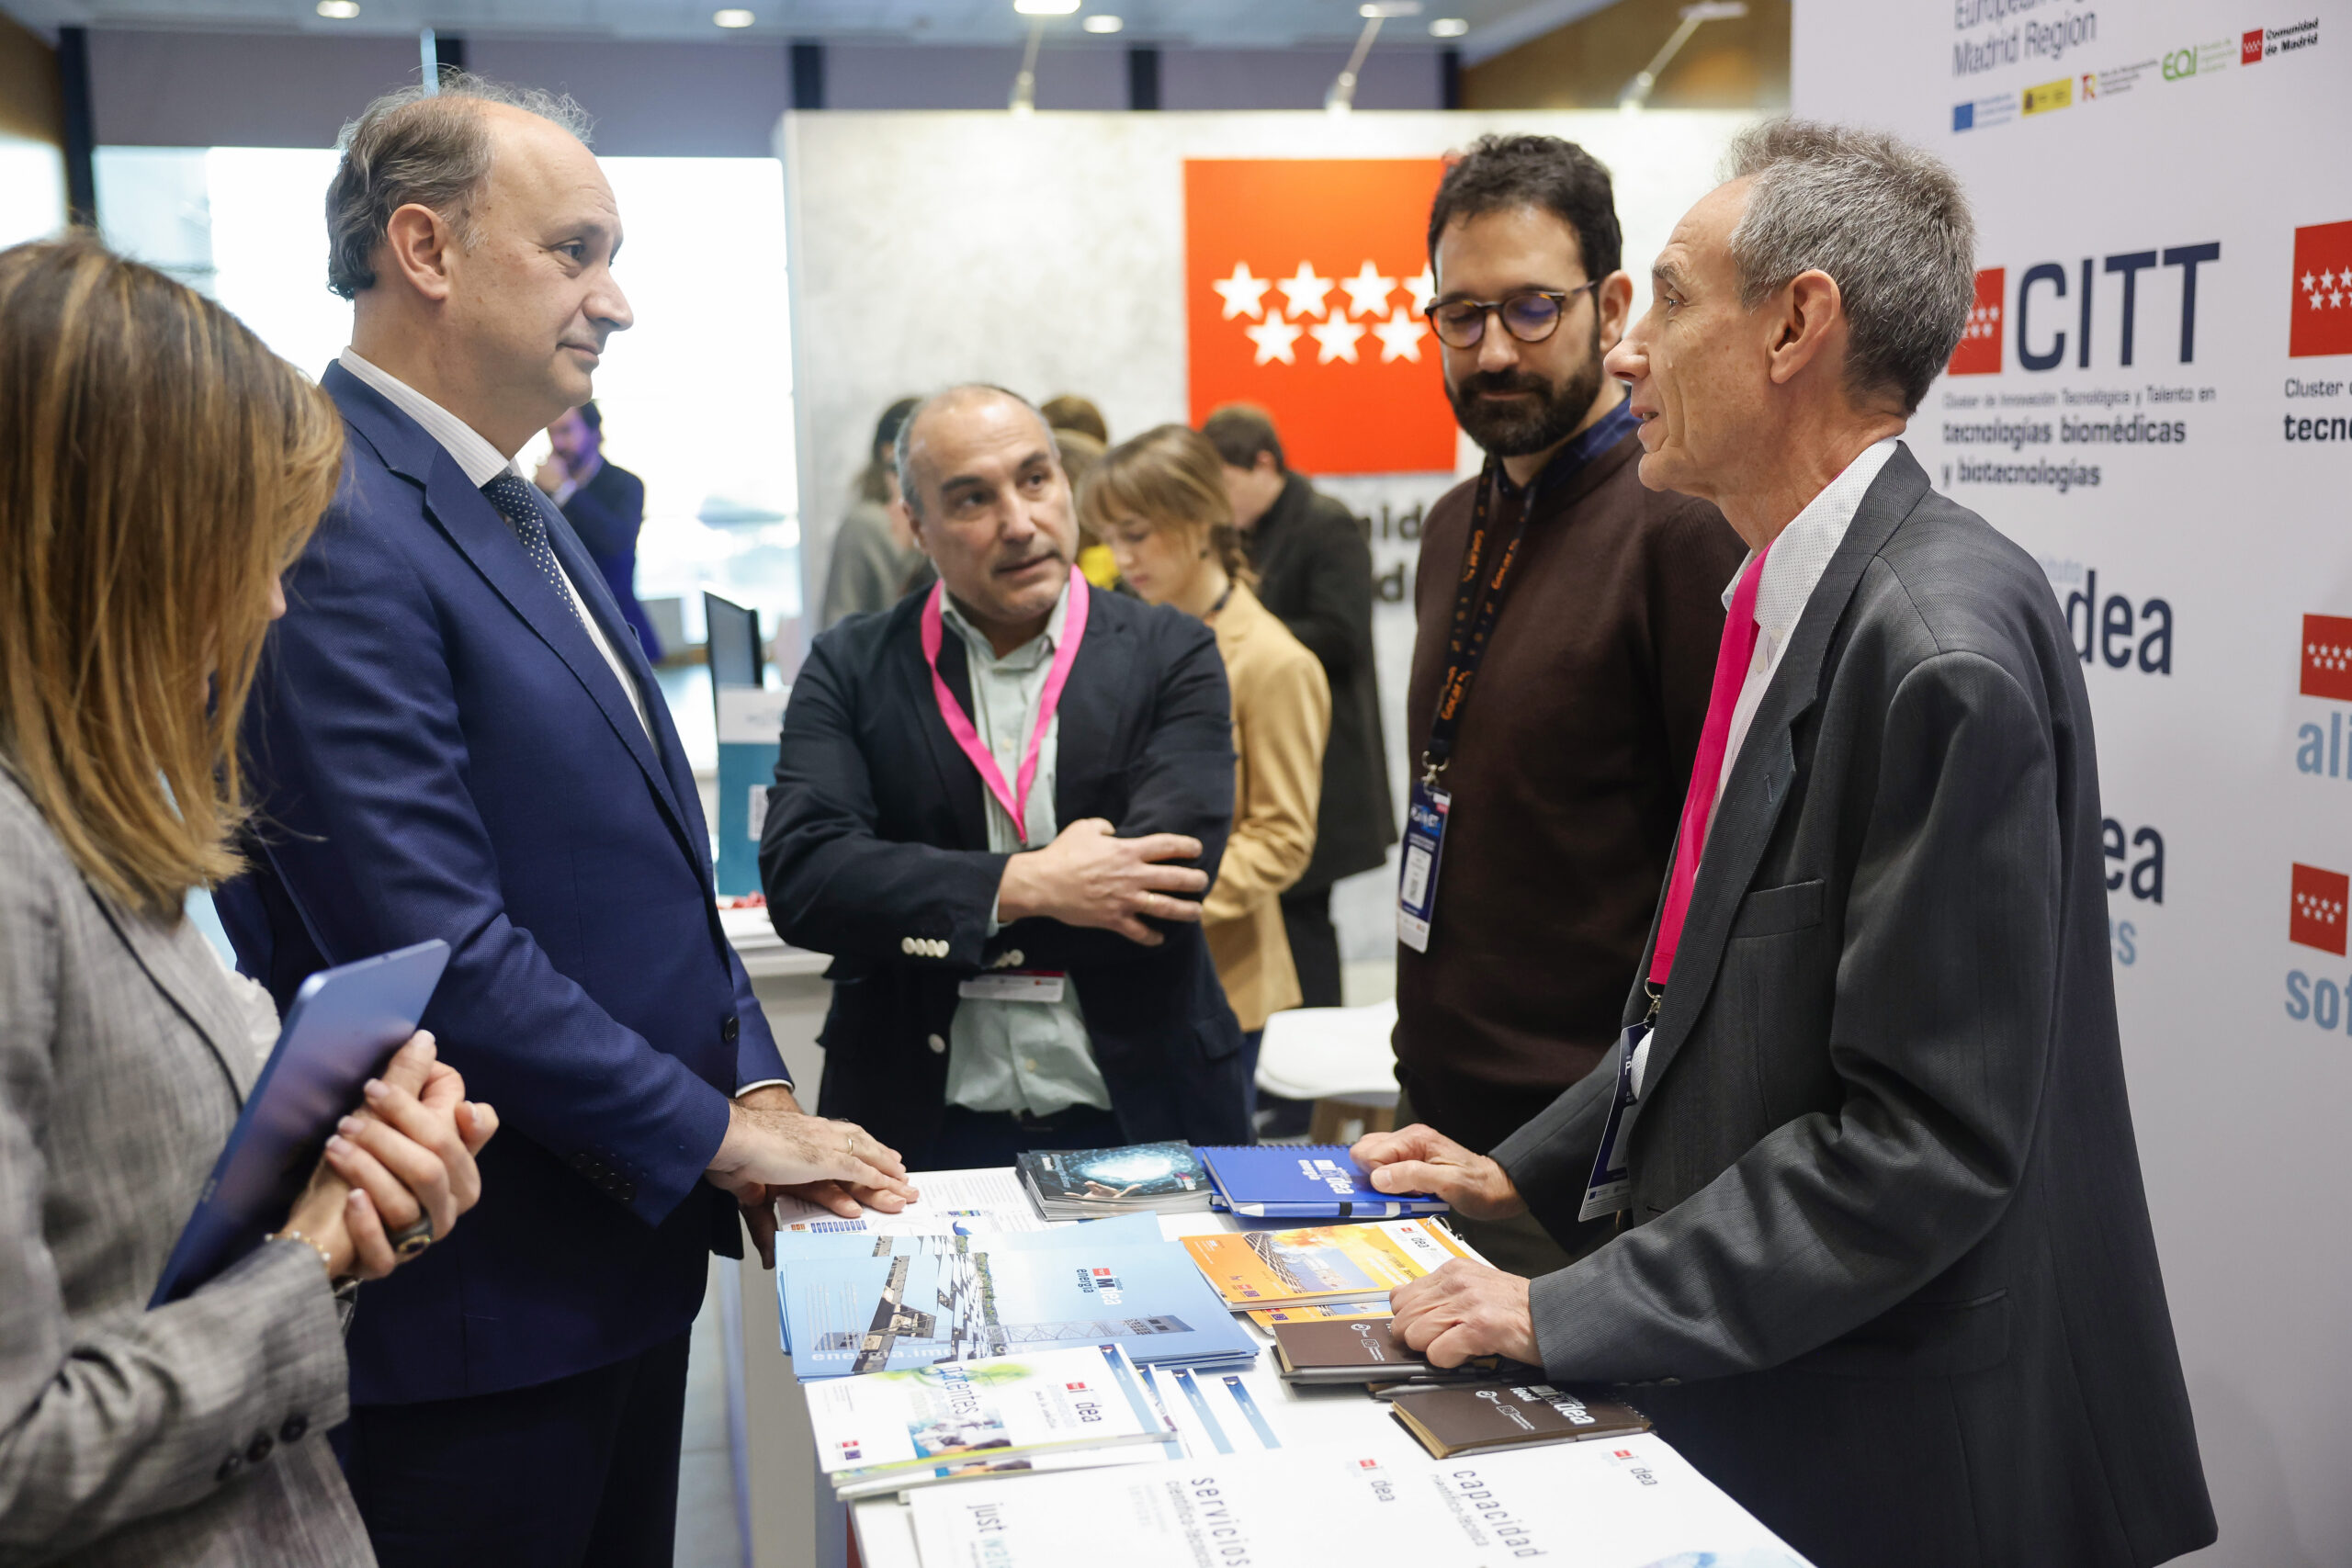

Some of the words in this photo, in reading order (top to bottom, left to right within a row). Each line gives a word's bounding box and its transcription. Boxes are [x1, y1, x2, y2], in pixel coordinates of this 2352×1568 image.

[1952, 26, 2019, 77] Madrid
[2024, 11, 2097, 61] Region
[2265, 17, 2318, 40] Comunidad
[2281, 31, 2318, 52] Madrid
[2016, 242, 2221, 372] CITT
[2146, 385, 2194, 402] Talento
[2198, 386, 2216, 402] en
[2285, 378, 2343, 398] Cluster
[1943, 414, 2052, 451] tecnologías
[2060, 413, 2187, 444] biomédicas
[2284, 412, 2352, 442] tecn
[1941, 463, 1952, 489] y
[1958, 456, 2101, 494] biotecnologías
[1510, 1387, 1541, 1403] food
[966, 1502, 1008, 1533] just
[1191, 1477, 1251, 1567] servicios
[1453, 1470, 1549, 1558] capacidad
